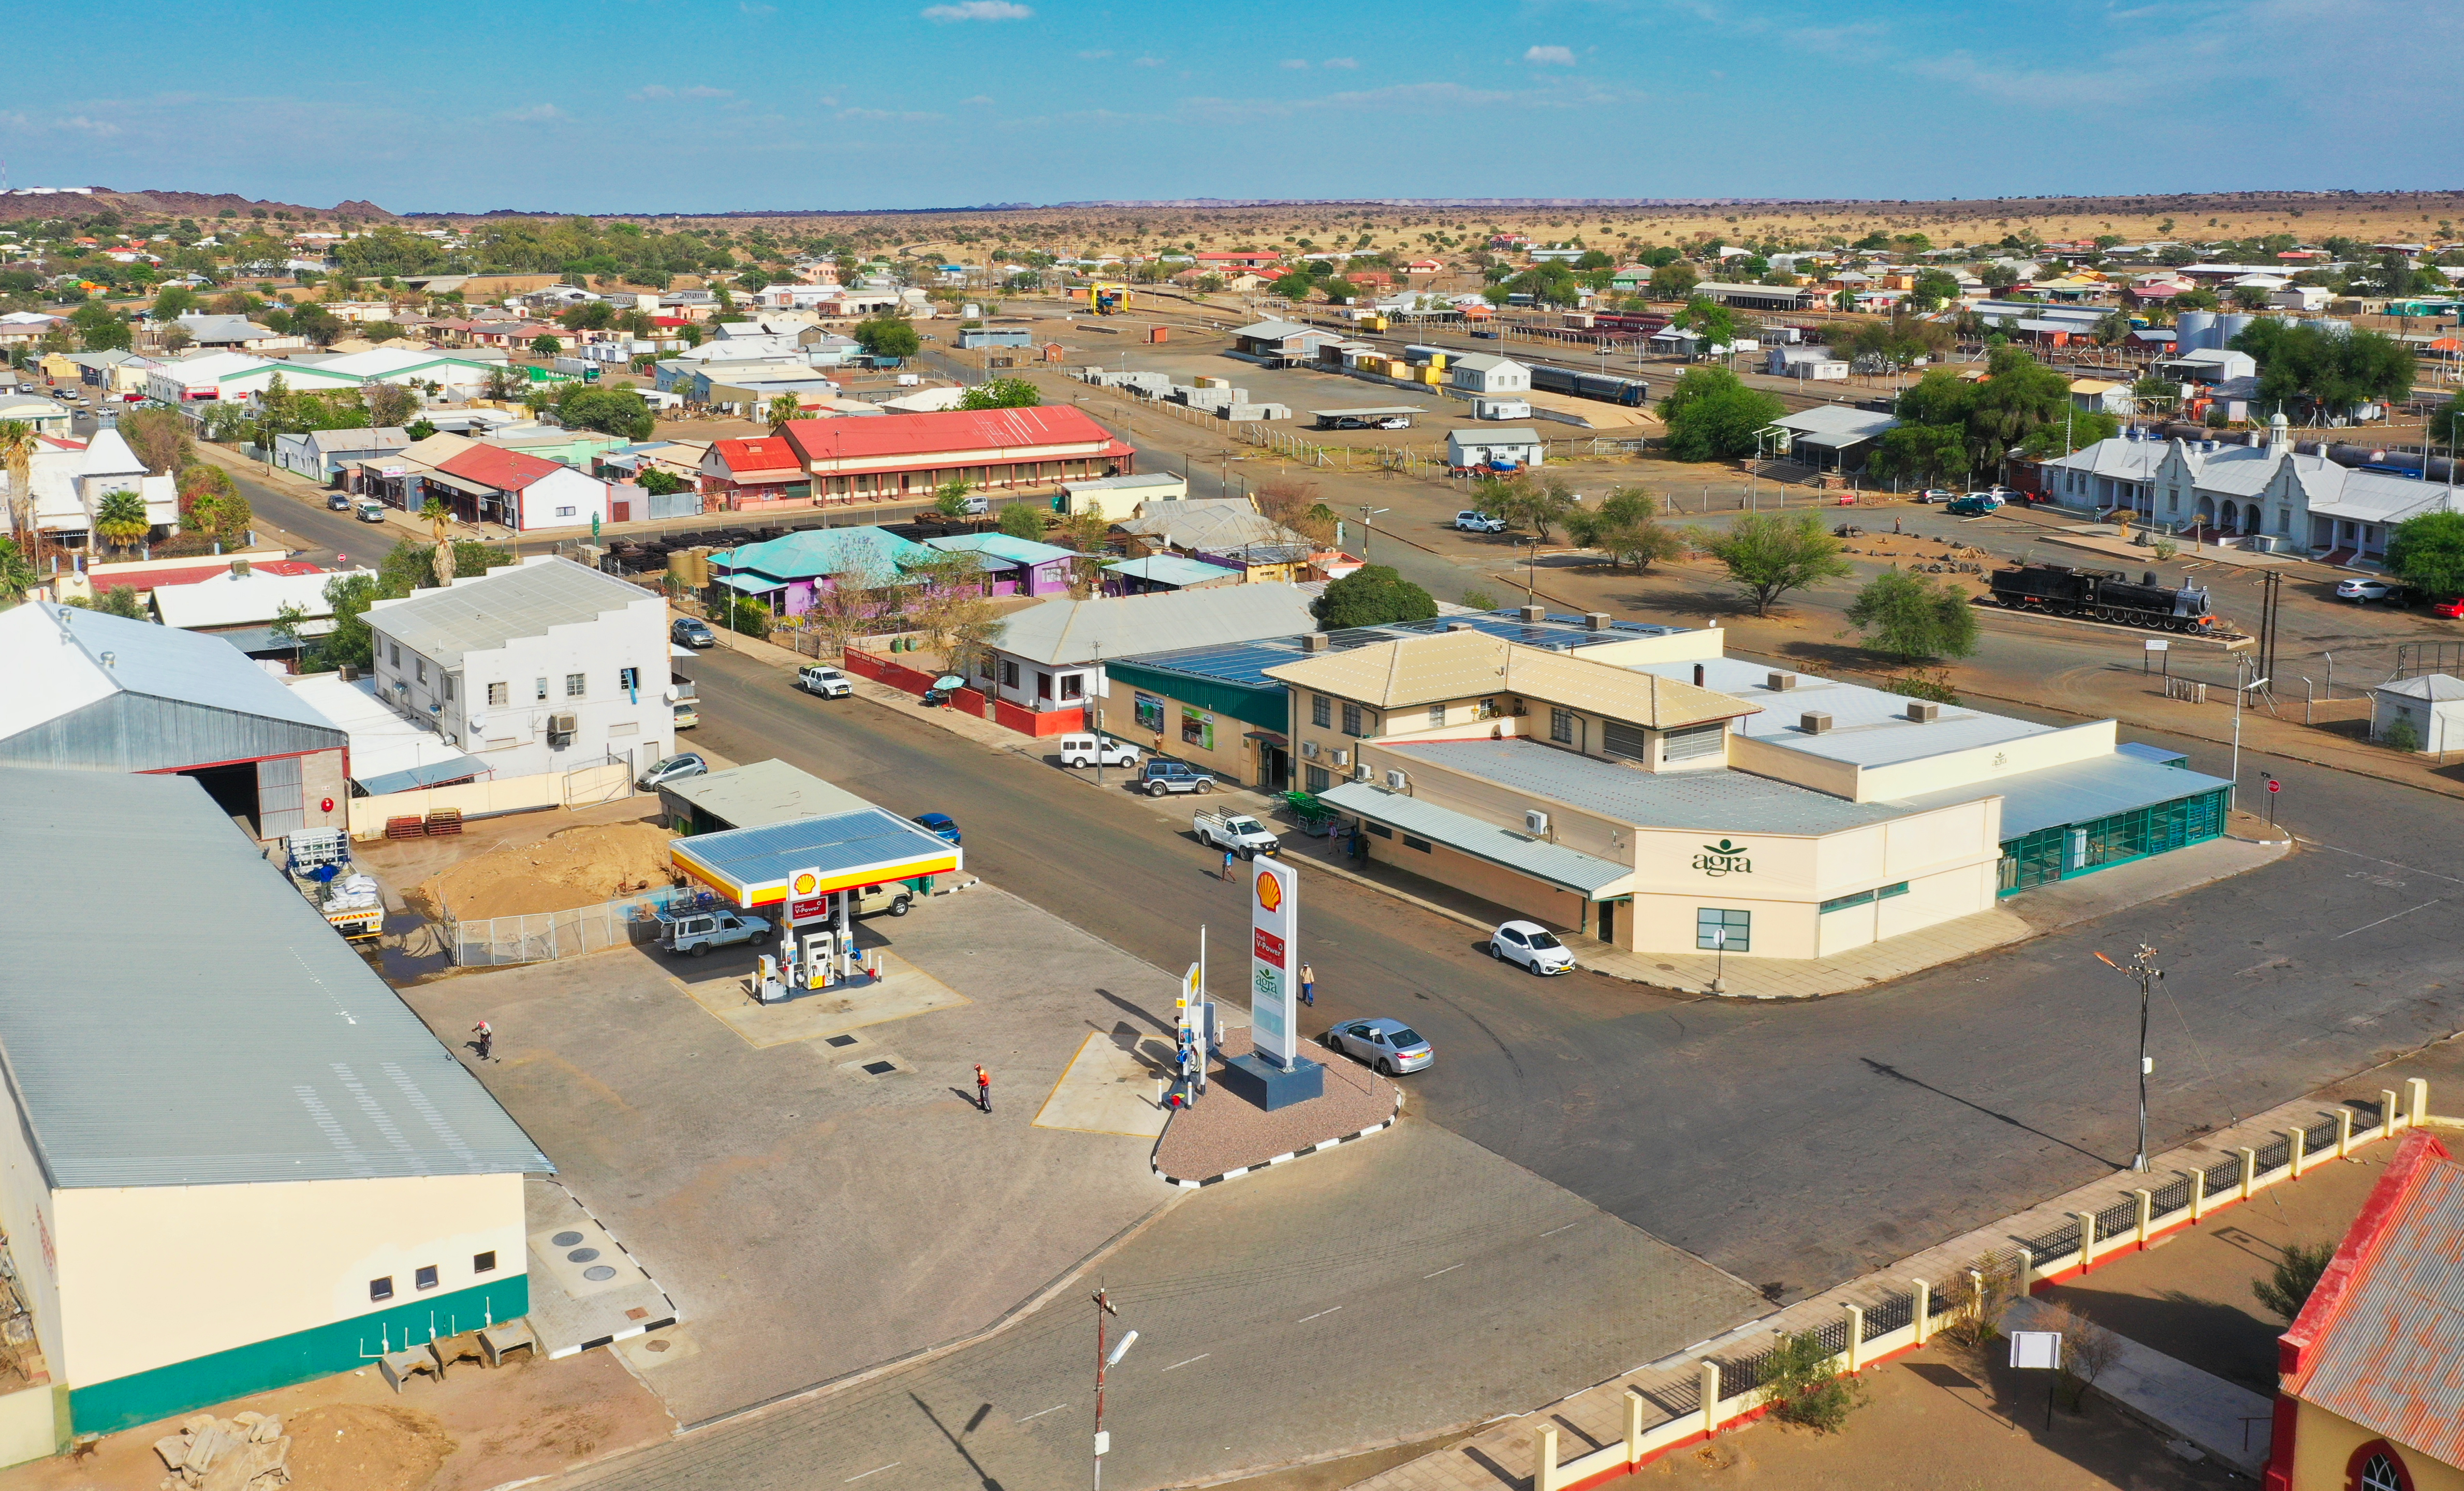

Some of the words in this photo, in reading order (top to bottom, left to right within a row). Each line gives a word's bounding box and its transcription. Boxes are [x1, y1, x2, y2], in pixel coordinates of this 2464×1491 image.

[846, 648, 861, 658] RACHELS
[871, 658, 886, 667] PACKERS
[1992, 758, 2007, 768] agra
[1692, 854, 1753, 877] agra
[1256, 933, 1266, 941] Shell
[1256, 939, 1281, 957] V-Power
[1256, 975, 1278, 994] agra
